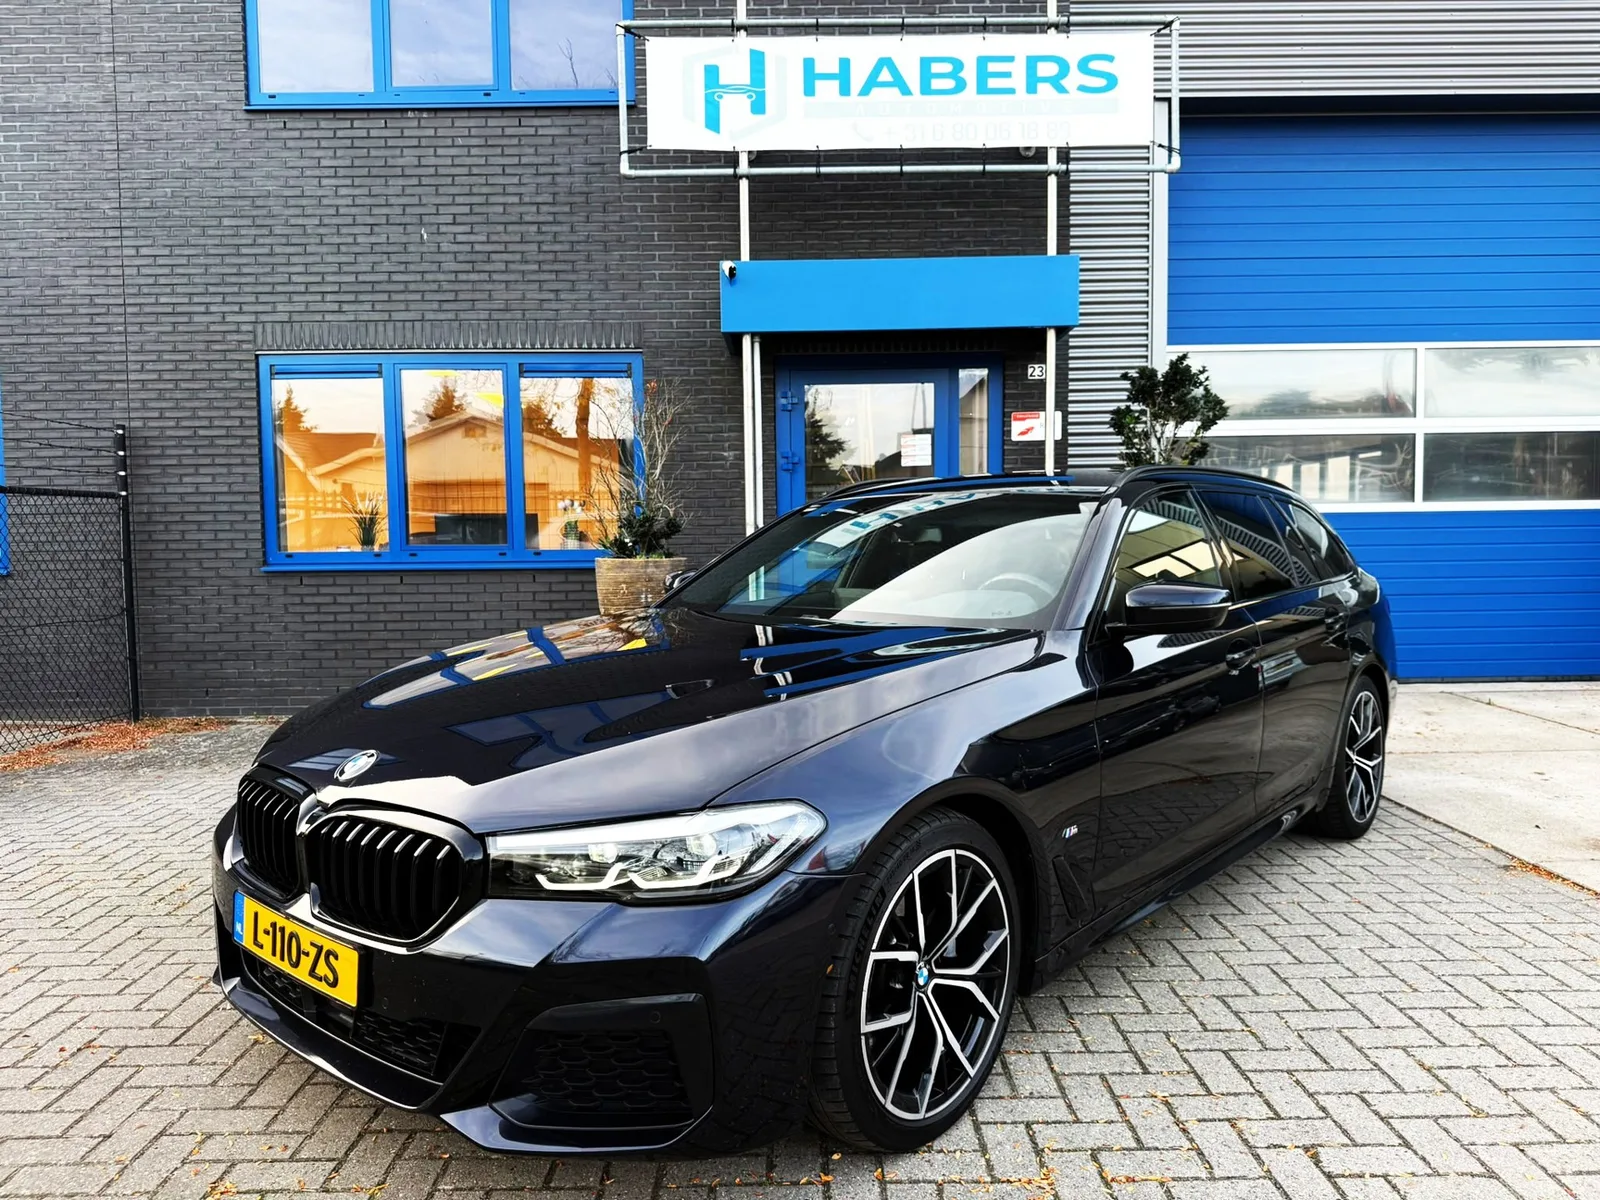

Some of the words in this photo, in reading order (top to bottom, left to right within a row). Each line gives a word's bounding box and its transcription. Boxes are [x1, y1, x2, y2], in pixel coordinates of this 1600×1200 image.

[803, 53, 1119, 97] HABERS
[856, 100, 1073, 117] AUTOMOTIVE
[952, 121, 977, 141] 80
[1029, 366, 1044, 378] 23
[253, 911, 339, 988] L-110-ZS
[848, 890, 885, 992] MICHELIN
